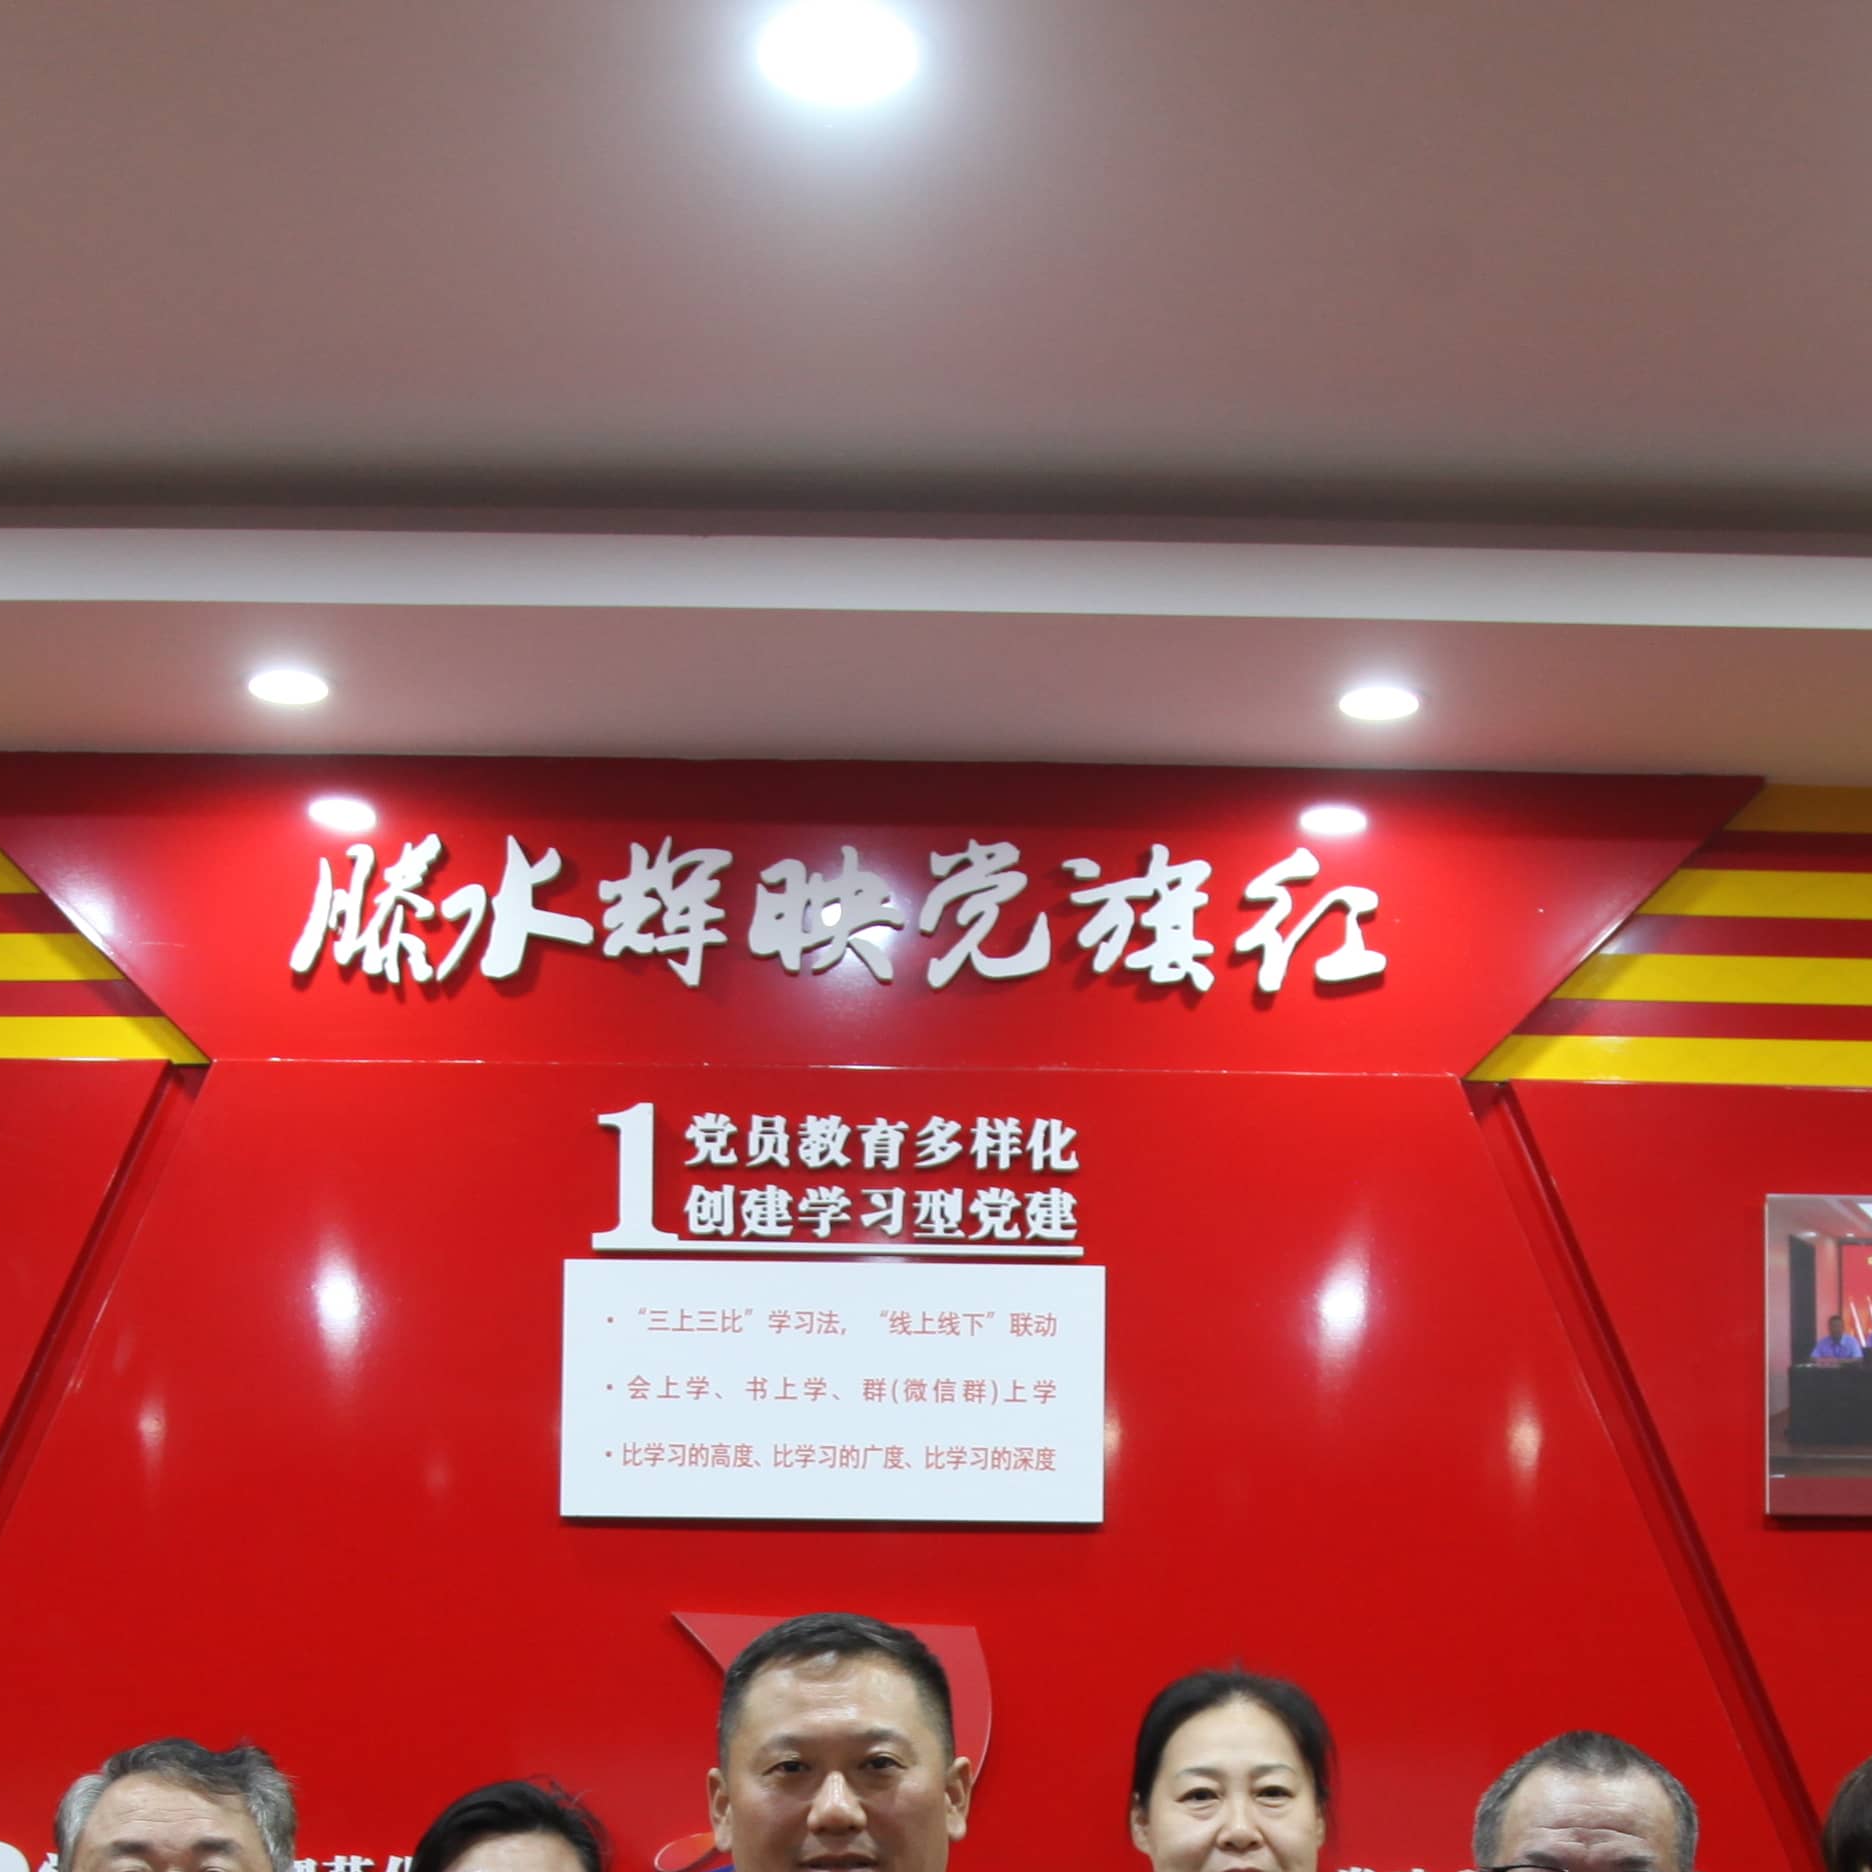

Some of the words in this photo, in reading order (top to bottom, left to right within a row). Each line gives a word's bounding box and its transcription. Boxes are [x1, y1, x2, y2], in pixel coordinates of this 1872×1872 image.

[289, 835, 1388, 996] 滕水辉映党旗红
[684, 1112, 1080, 1172] 党员教育多样化
[592, 1102, 680, 1250] 1
[684, 1184, 1079, 1240] 创建学习型党建
[622, 1442, 1056, 1473] 比学习的高度、比学习的广度、比学习的深度
